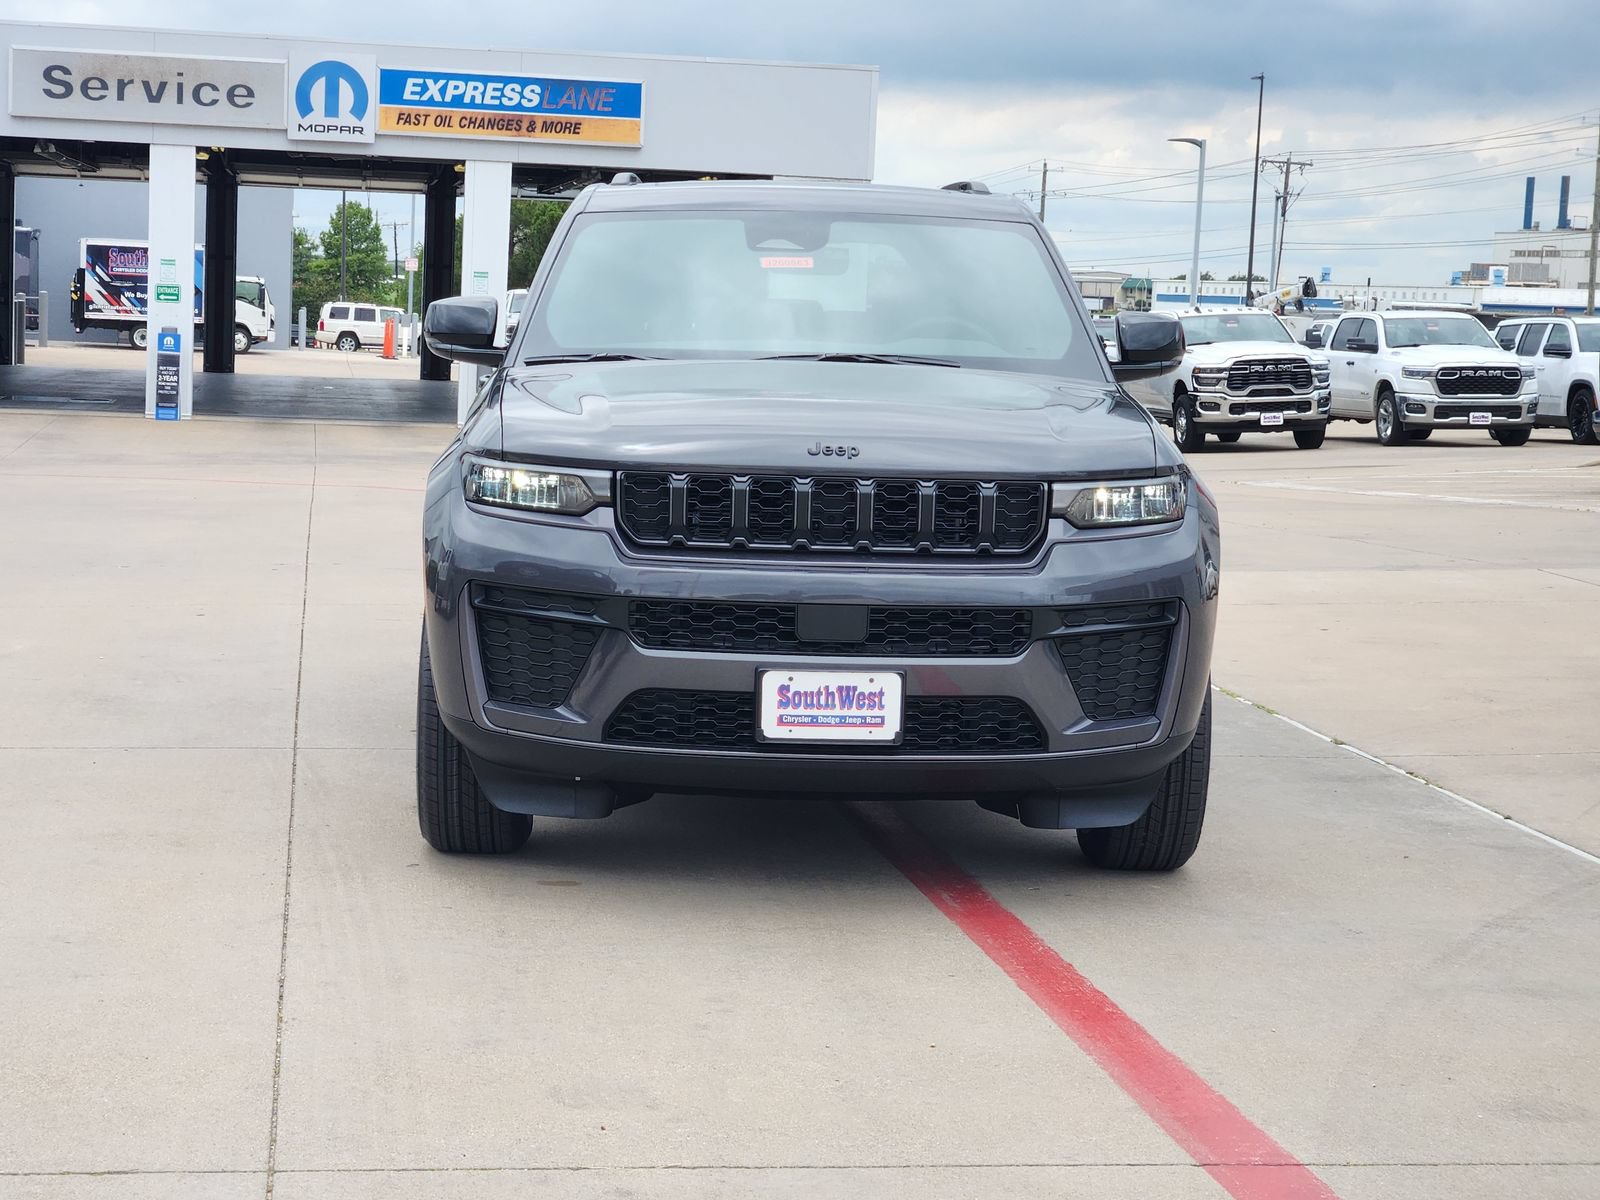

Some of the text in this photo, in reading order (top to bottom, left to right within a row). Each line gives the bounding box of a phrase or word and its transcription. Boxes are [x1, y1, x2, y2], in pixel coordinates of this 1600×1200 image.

[42, 64, 256, 109] Service
[298, 123, 365, 135] MOPAR
[396, 112, 582, 135] FAST OIL CHANGES & MORE
[1250, 364, 1292, 372] RAM
[807, 442, 860, 459] Jeep
[777, 684, 885, 710] SouthWest
[782, 716, 812, 724] Chrysler
[818, 716, 840, 724] Dodge
